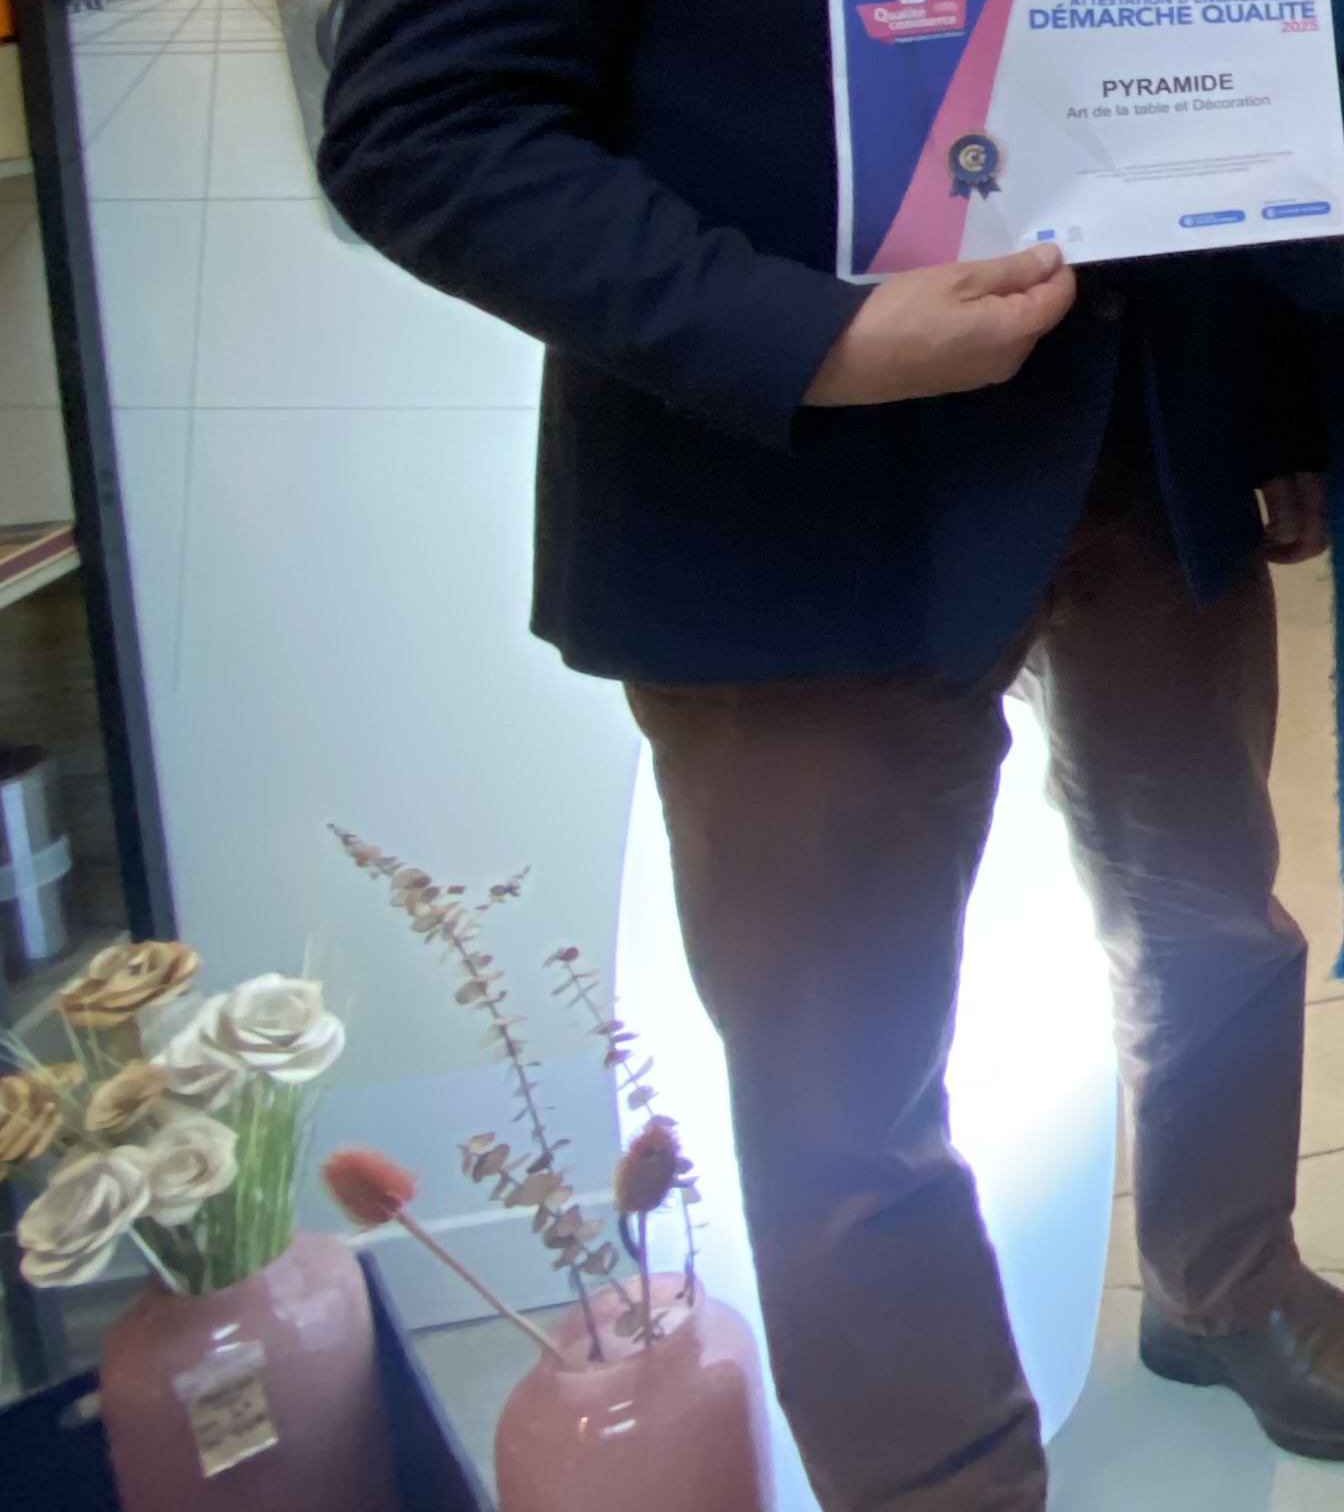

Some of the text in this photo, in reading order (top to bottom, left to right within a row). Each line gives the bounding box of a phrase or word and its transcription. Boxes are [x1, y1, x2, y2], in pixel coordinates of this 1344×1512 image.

[1028, 3, 1194, 30] DÉMARCHE
[1280, 20, 1320, 33] 2025
[1102, 73, 1235, 98] PYRAMIDE
[1066, 95, 1271, 120] Art de la table et Décoration
